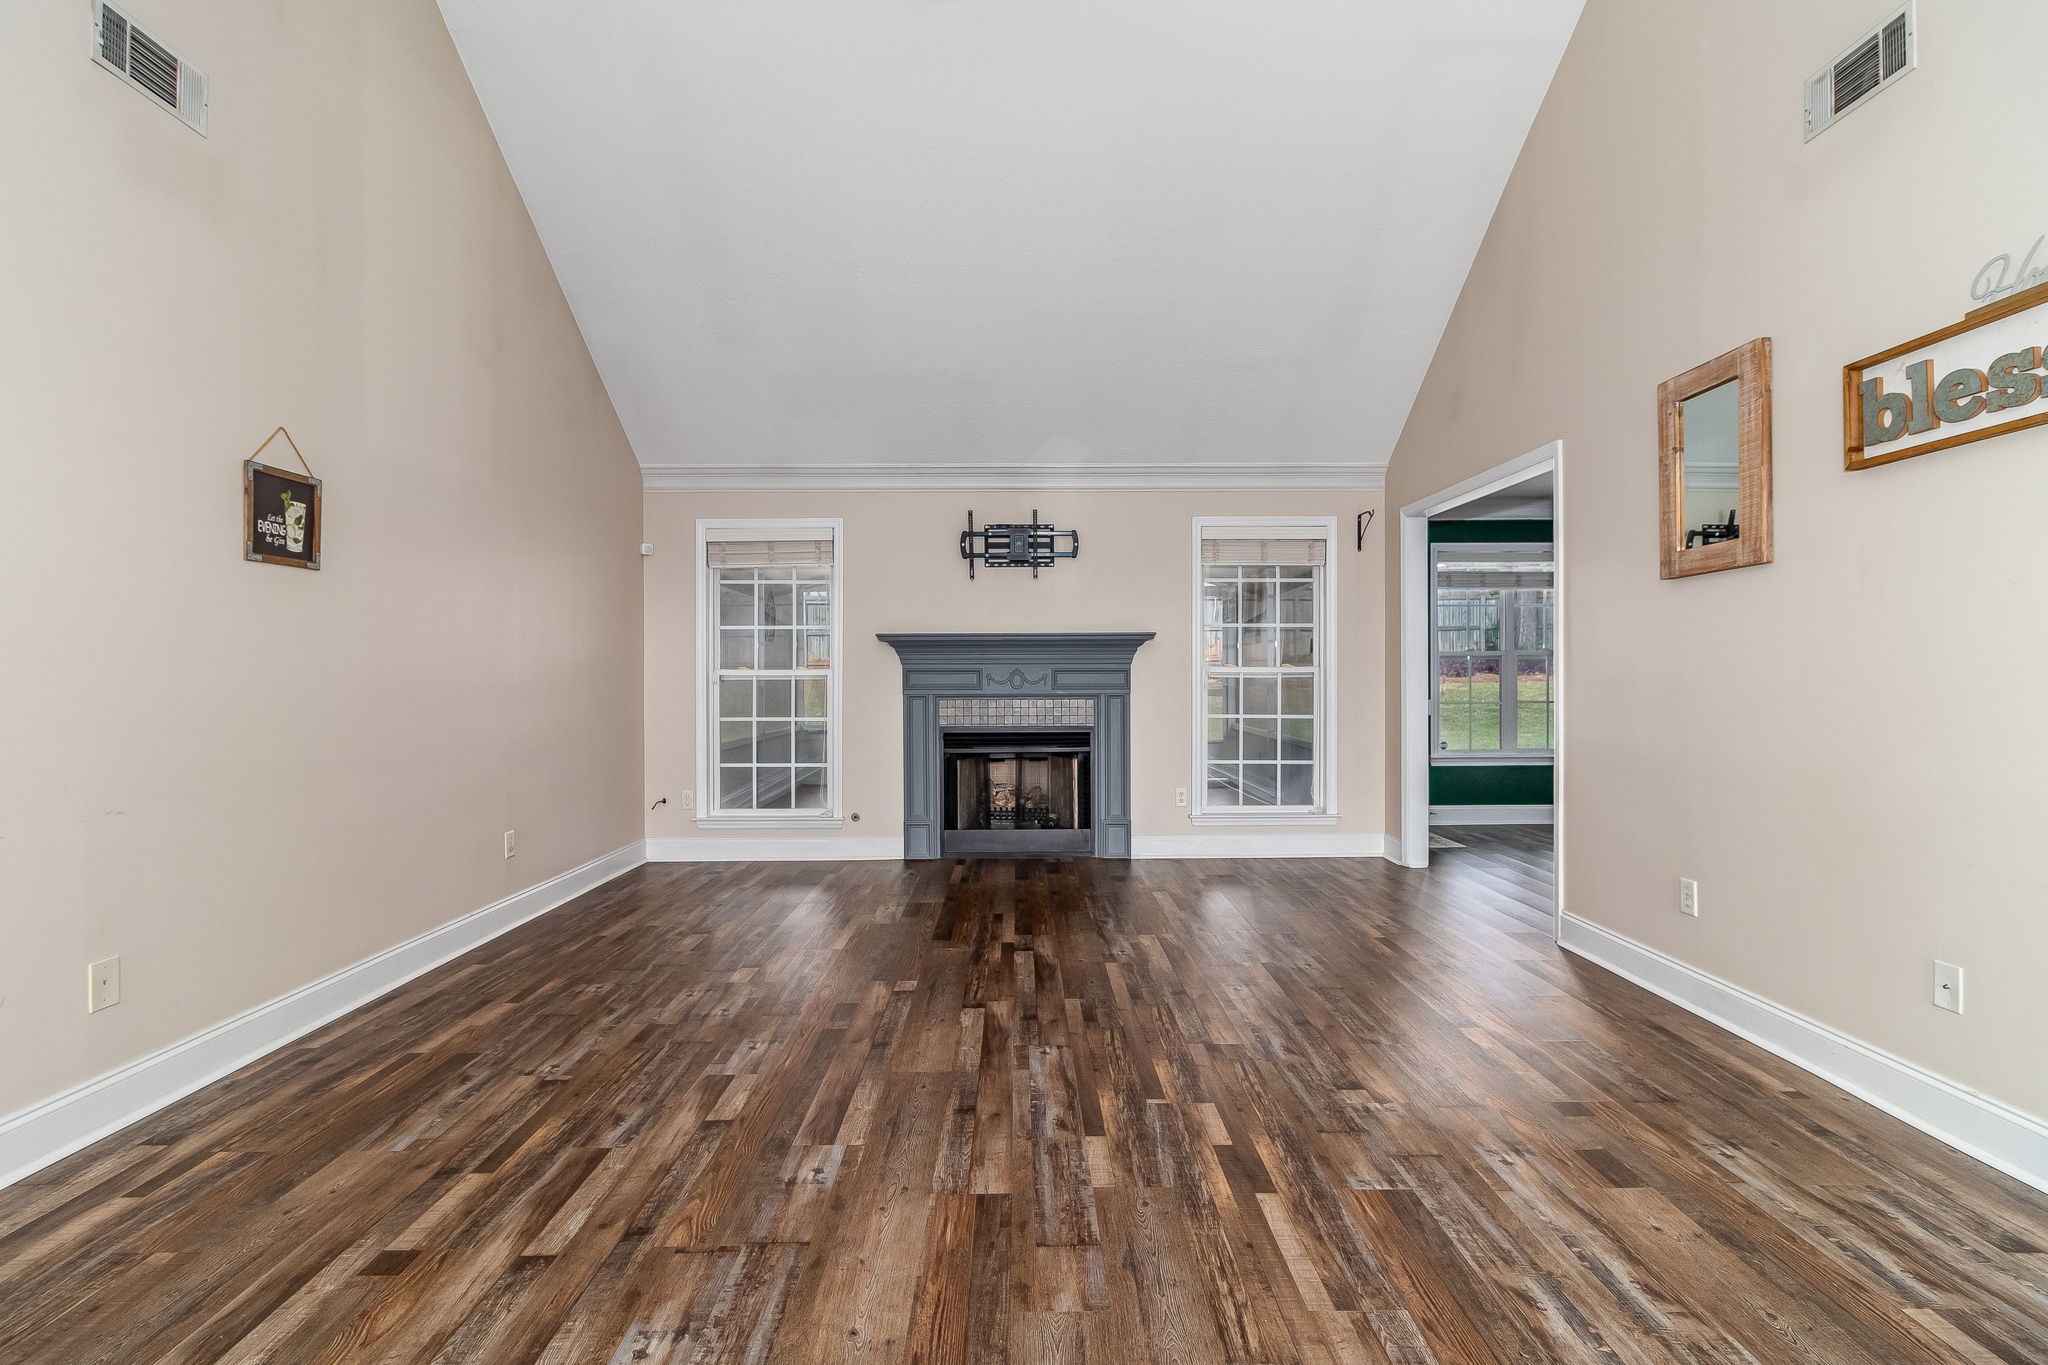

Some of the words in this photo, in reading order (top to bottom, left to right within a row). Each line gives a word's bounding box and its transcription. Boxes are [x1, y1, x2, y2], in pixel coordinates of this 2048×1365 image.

[1859, 345, 2048, 447] bles
[267, 513, 276, 522] Let
[276, 514, 284, 523] the
[257, 519, 287, 536] EVENING
